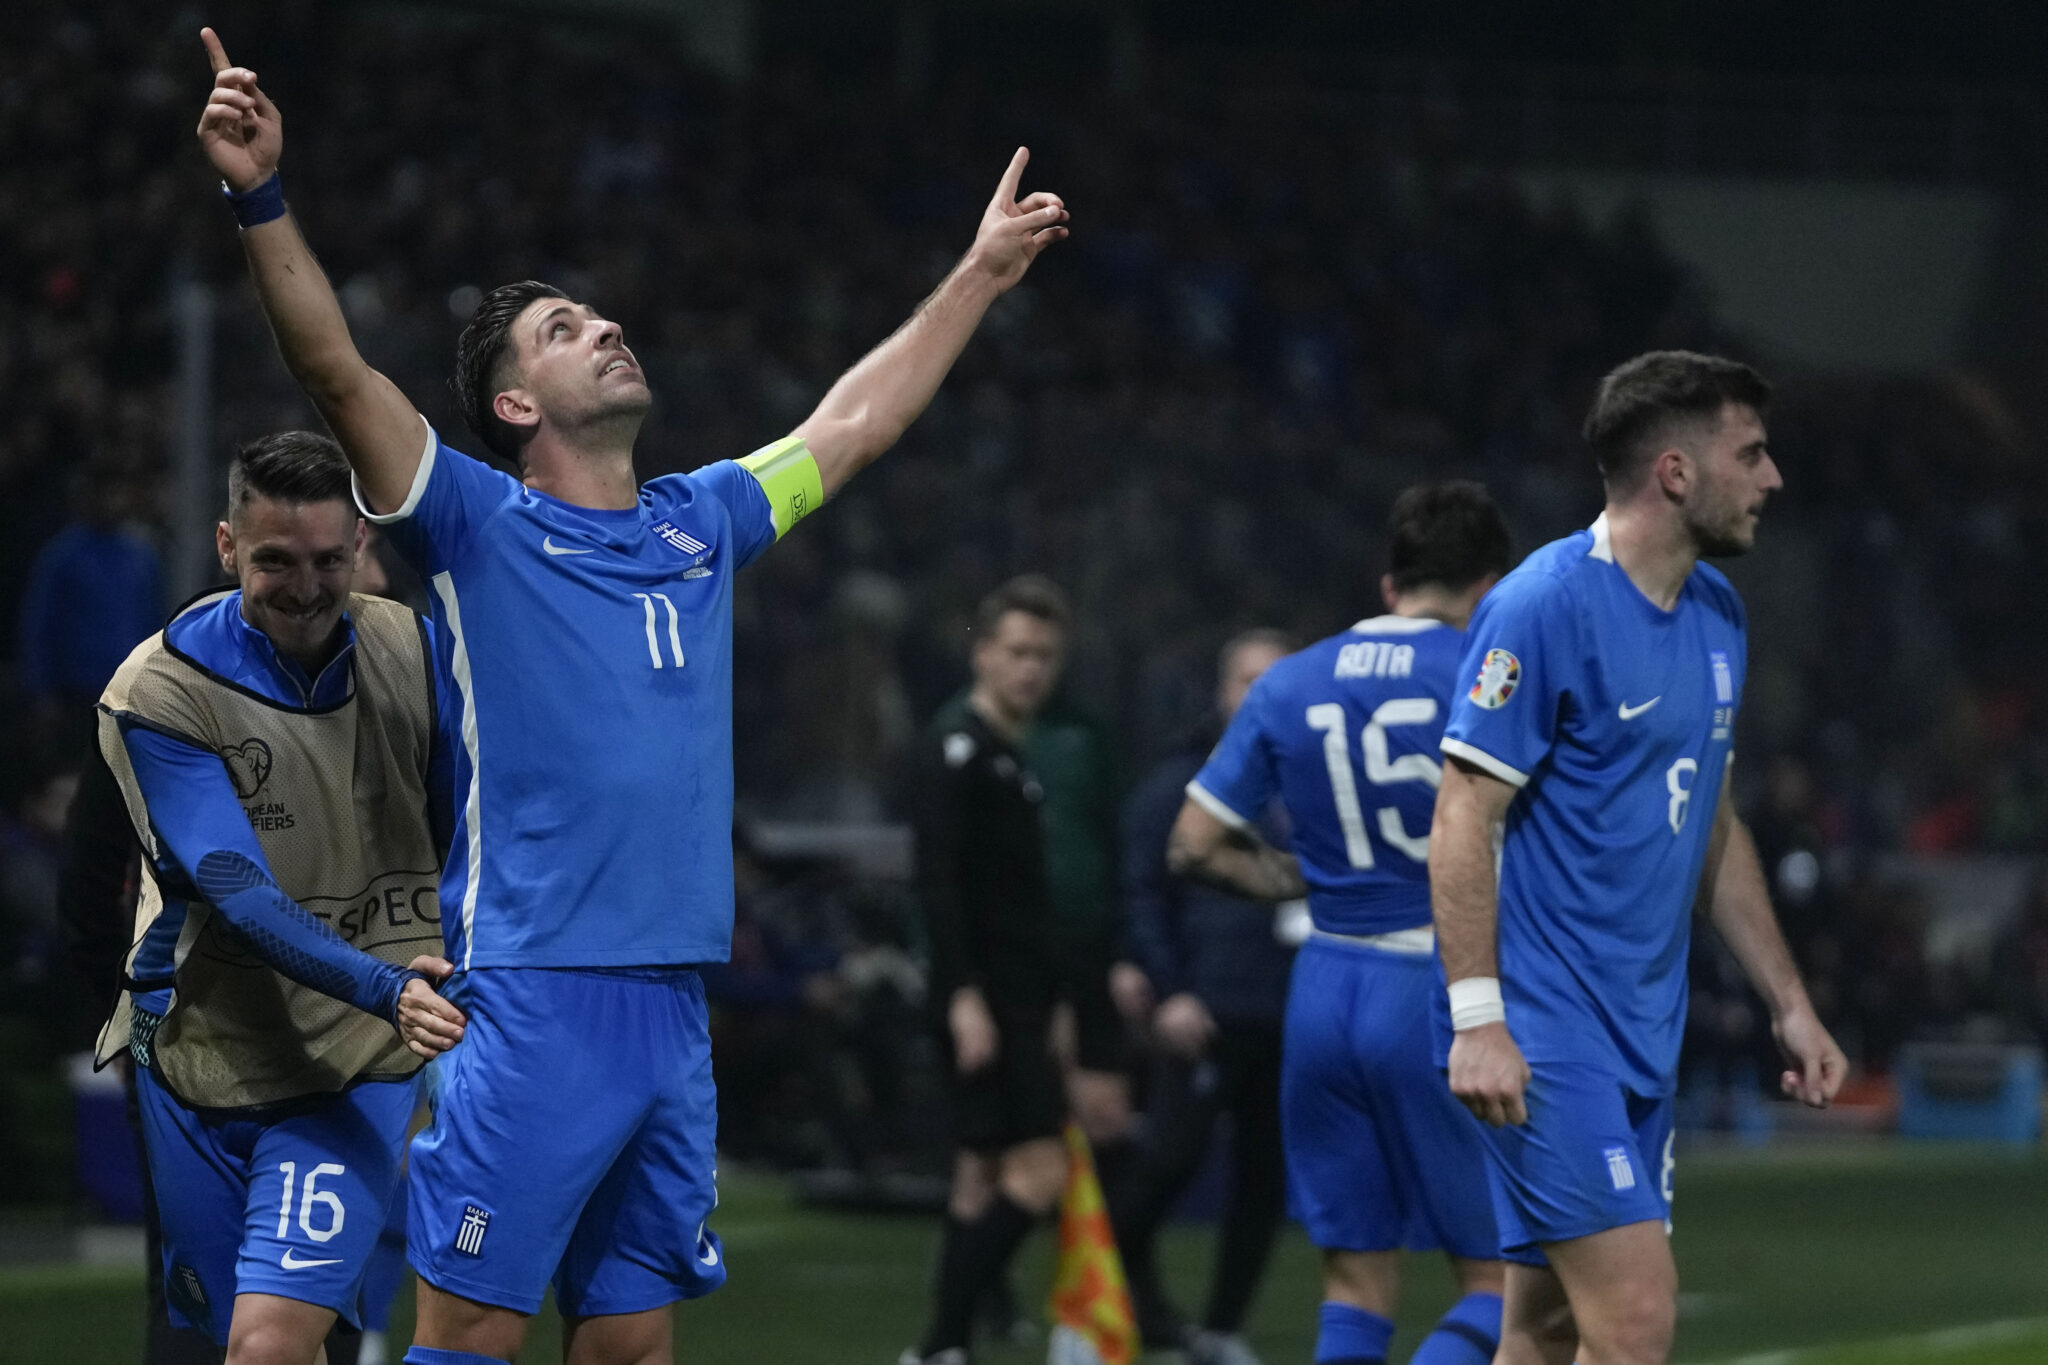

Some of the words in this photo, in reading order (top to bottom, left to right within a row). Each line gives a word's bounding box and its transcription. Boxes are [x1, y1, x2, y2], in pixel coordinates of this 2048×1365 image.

[631, 592, 684, 669] 11
[1334, 642, 1415, 679] ROTA
[1306, 698, 1442, 869] 15
[1667, 758, 1698, 834] 8
[277, 1161, 345, 1242] 16
